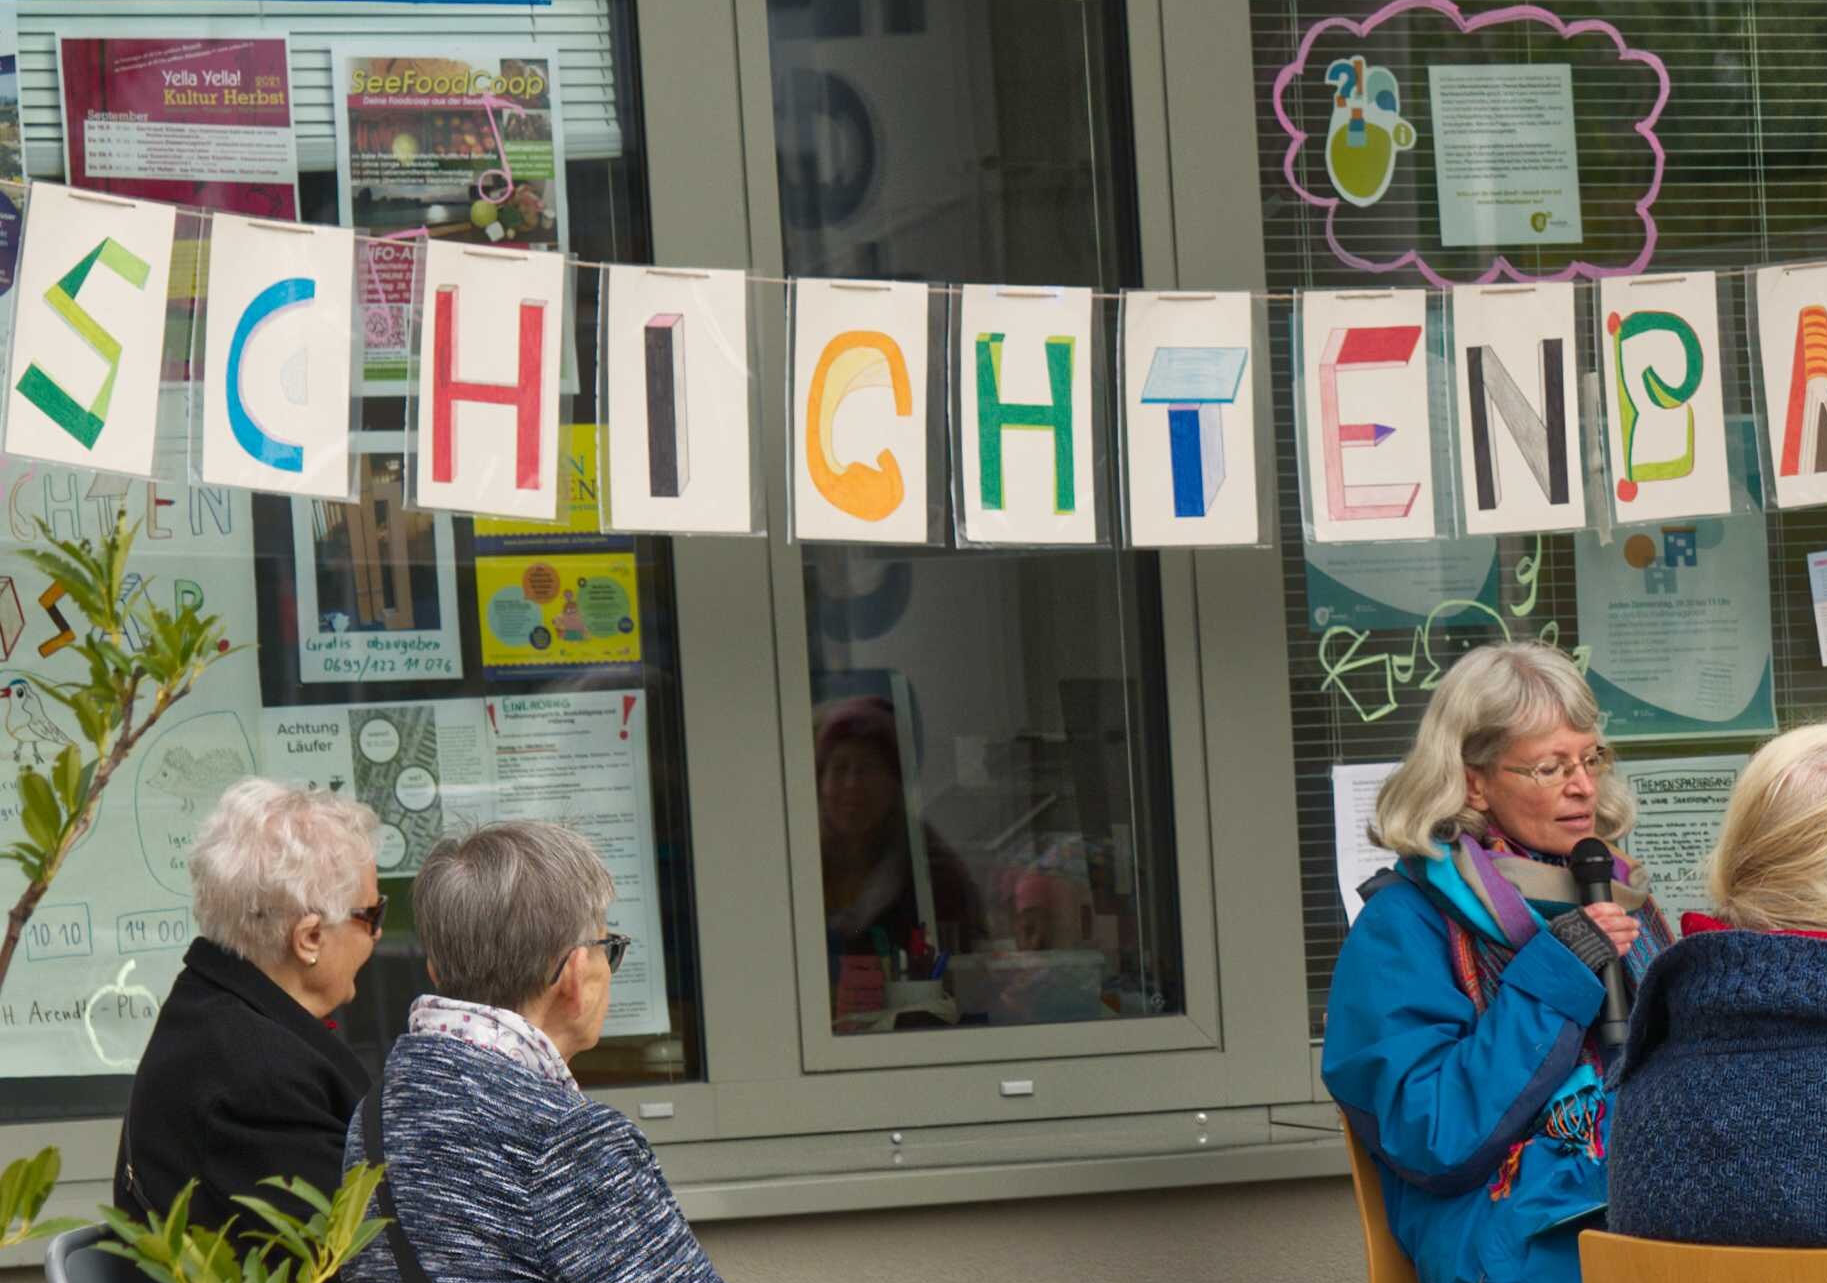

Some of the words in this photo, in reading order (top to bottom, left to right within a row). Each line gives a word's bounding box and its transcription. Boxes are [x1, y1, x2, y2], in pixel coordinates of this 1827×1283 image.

[162, 69, 198, 87] Yella
[202, 69, 241, 87] Yella!
[351, 68, 546, 99] SeeFoodCoop
[163, 88, 218, 107] Kultur
[223, 88, 286, 107] Herbst
[304, 636, 353, 652] Gratis
[276, 722, 340, 736] Achtung
[286, 740, 332, 754] Läufer
